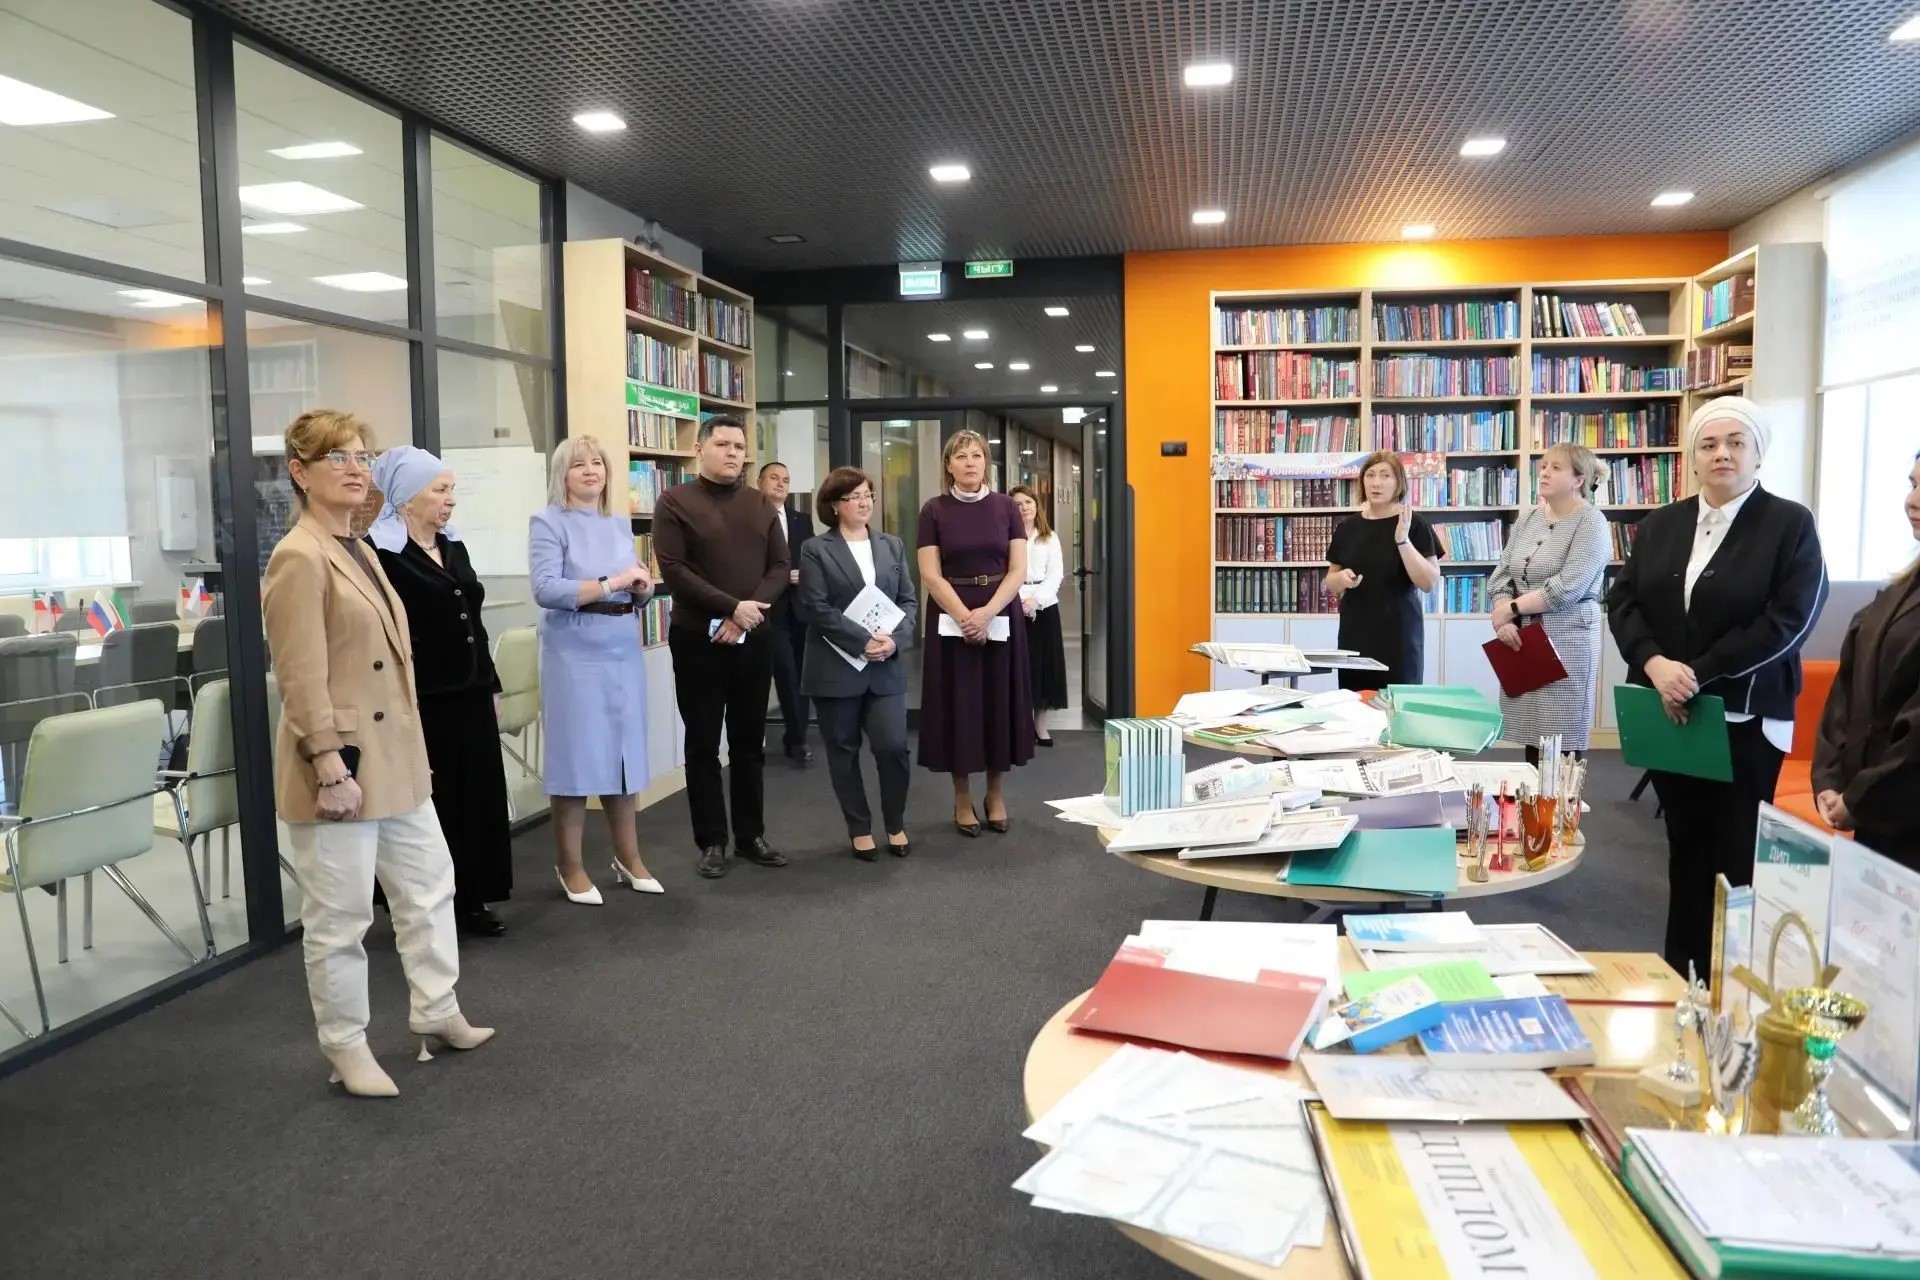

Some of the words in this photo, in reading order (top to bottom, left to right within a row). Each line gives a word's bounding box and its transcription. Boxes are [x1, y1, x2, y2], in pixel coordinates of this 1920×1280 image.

[973, 264, 1004, 274] ЧЫГУ
[1327, 464, 1362, 477] народ
[1410, 1129, 1528, 1273] ДИПЛОМ
